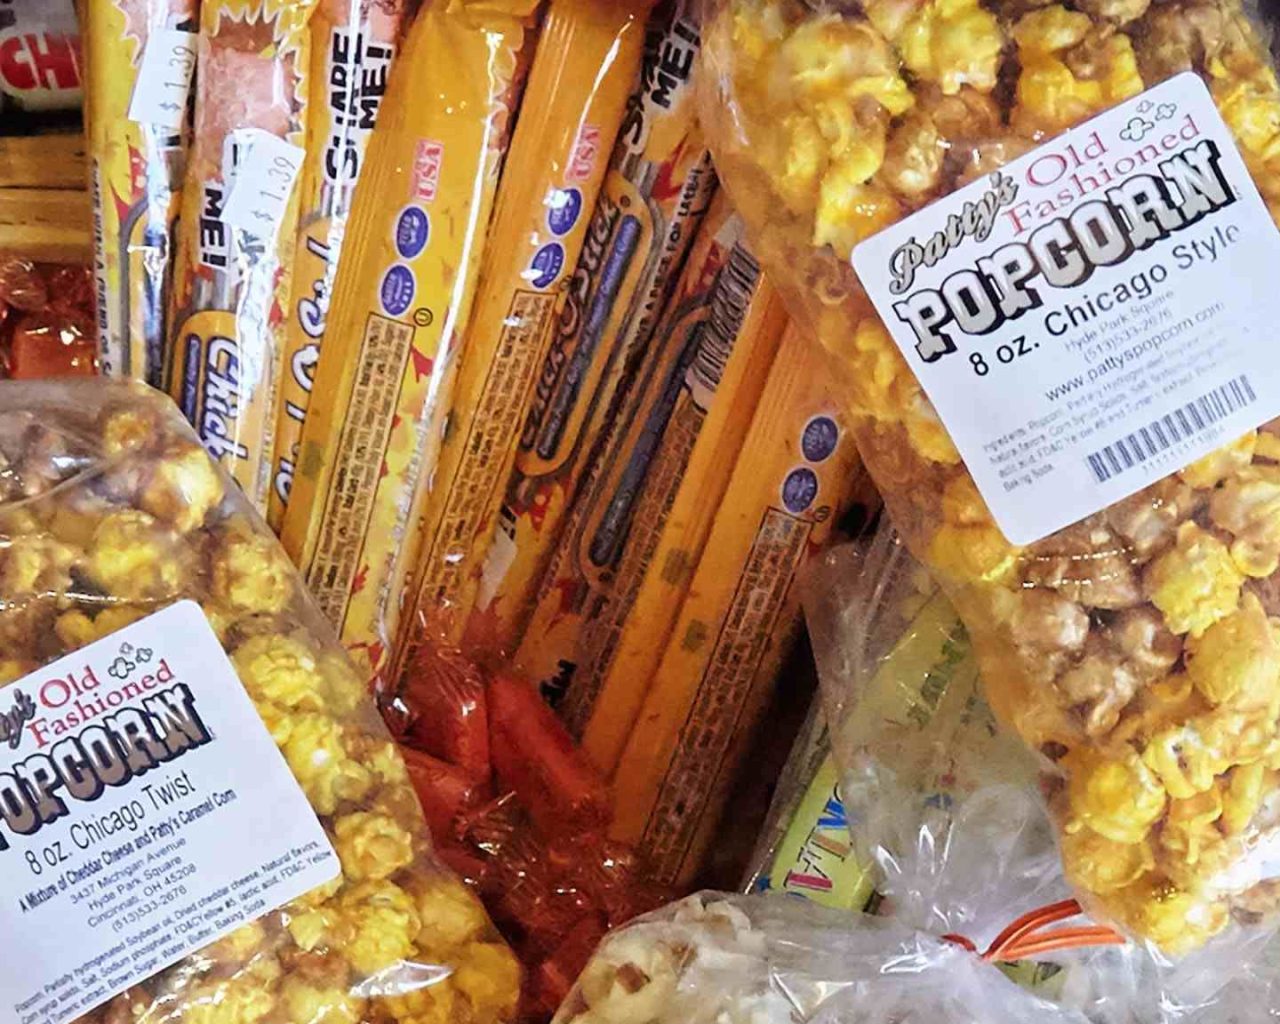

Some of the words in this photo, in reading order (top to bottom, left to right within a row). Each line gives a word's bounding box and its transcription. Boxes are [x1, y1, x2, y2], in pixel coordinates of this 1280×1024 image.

[164, 46, 193, 90] 1.39
[357, 45, 394, 130] ME!
[257, 155, 295, 202] 1.39
[1001, 114, 1202, 237] Fashioned
[1025, 130, 1109, 188] Old
[200, 187, 227, 269] ME!
[890, 171, 1020, 295] Patty's
[892, 139, 1237, 363] POPCORN
[968, 351, 990, 377] 8
[995, 334, 1040, 364] oz.
[1043, 263, 1168, 337] Chicago
[1063, 329, 1098, 352] Hyde
[1098, 313, 1130, 334] Park
[24, 657, 176, 749] Fashioned
[38, 664, 101, 709] Old
[0, 682, 213, 853] OPCORN
[18, 898, 29, 913] A
[24, 883, 59, 910] Mixture
[56, 873, 69, 892] of
[64, 857, 104, 886] Cheddar
[100, 841, 135, 866] Cheese
[133, 829, 153, 850] and
[147, 816, 181, 841] Patty's
[177, 796, 215, 825] Caramel
[211, 788, 237, 807] Corn
[23, 849, 43, 876] 8
[42, 840, 73, 867] oz.
[69, 799, 146, 850] Chicago
[139, 769, 196, 811] Twist
[69, 882, 95, 905] 3437
[96, 858, 149, 890] Michigan
[146, 837, 187, 864] Avenue
[86, 890, 117, 911] Hyde
[115, 877, 143, 895] Park
[142, 855, 183, 881] Square
[142, 880, 163, 897] OH
[163, 862, 197, 886] 45208
[213, 910, 245, 930] Baking
[242, 898, 266, 915] Soda
